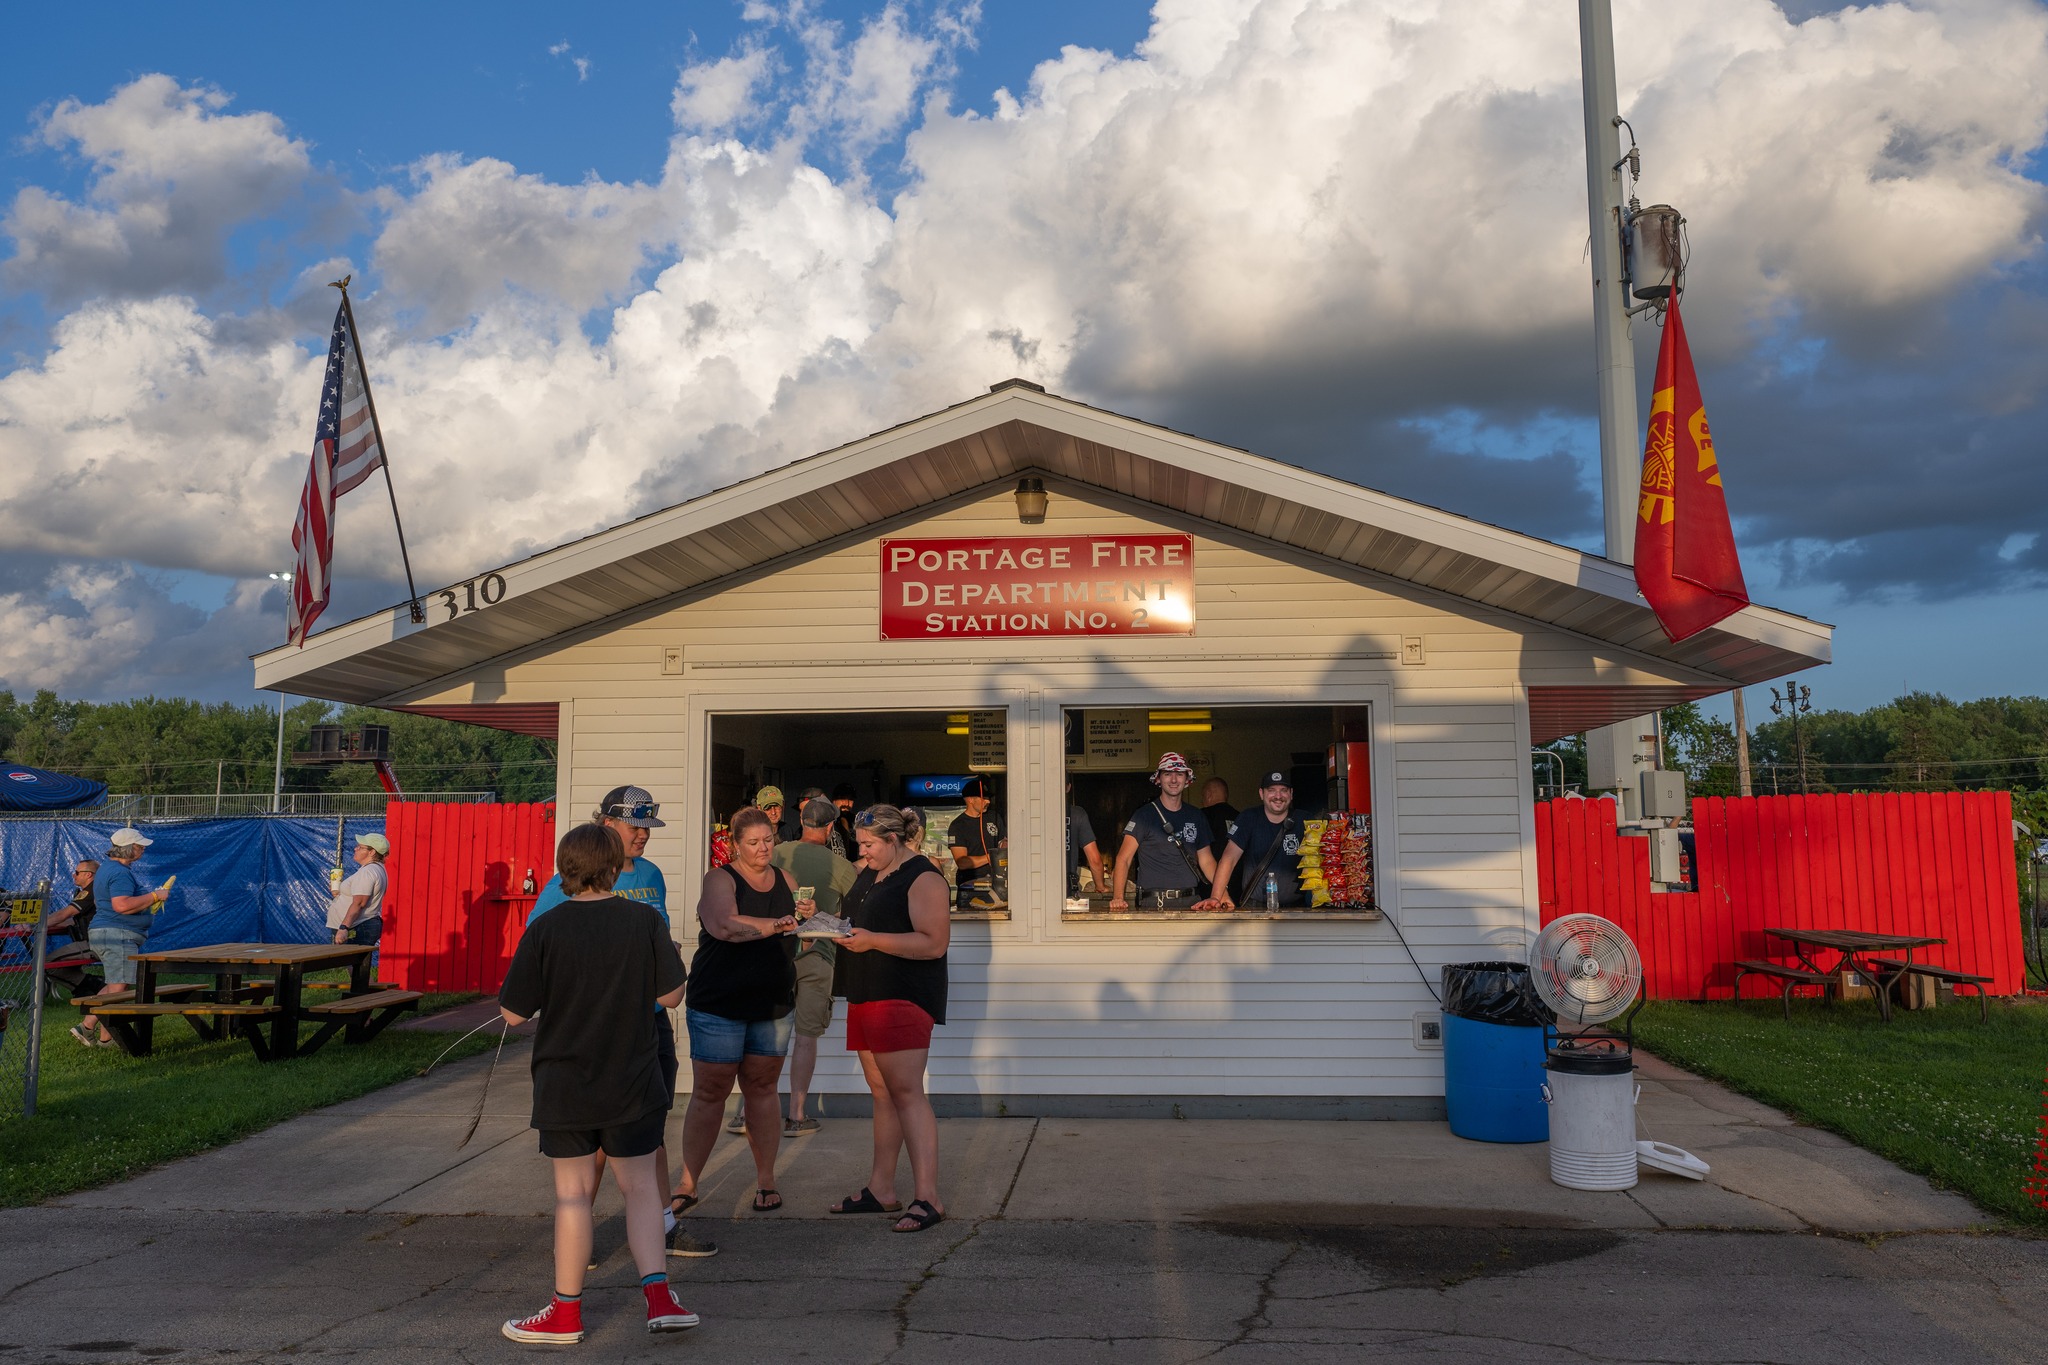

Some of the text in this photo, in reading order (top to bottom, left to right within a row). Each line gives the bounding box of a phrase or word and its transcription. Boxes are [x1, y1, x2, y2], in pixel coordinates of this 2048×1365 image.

[890, 541, 1185, 573] PORTAGE FIRE
[440, 573, 507, 620] 310
[901, 579, 1173, 607] DEPARTMENT
[925, 613, 1050, 633] STATION
[1131, 608, 1149, 628] 2
[935, 781, 961, 791] pepsi
[20, 900, 37, 914] D.J.
